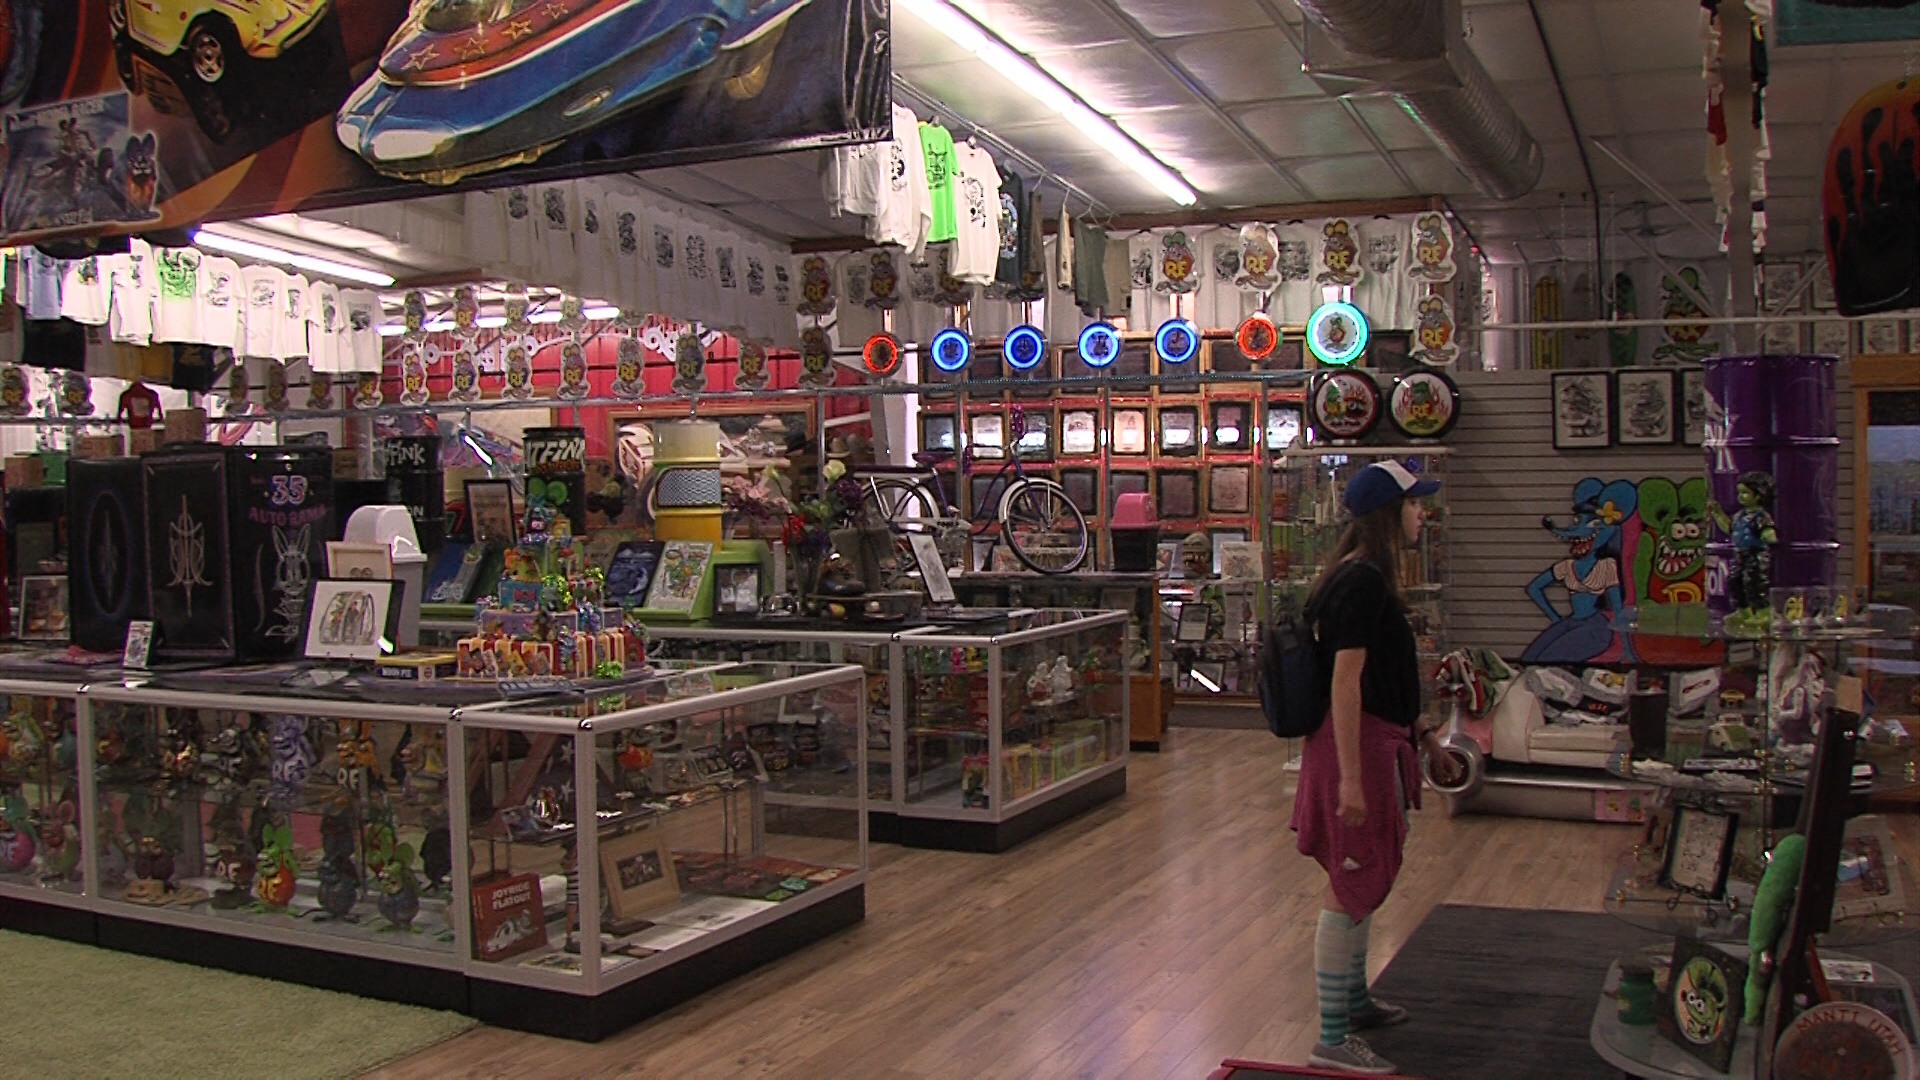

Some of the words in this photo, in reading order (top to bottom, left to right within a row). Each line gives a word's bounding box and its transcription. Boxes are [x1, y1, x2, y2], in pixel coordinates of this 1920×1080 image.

[1327, 250, 1350, 269] RF
[1419, 245, 1442, 264] RF
[1164, 259, 1187, 277] RF
[1246, 255, 1268, 273] RF
[806, 282, 826, 298] RF
[872, 280, 892, 294] RF
[1421, 327, 1444, 346] RF
[621, 364, 639, 377] RF
[806, 355, 826, 370] RF
[406, 378, 420, 391] RF
[565, 369, 580, 383] RF
[271, 474, 309, 506] 35
[1796, 1009, 1859, 1032] MANTI
[1868, 1019, 1903, 1056] UTAH
